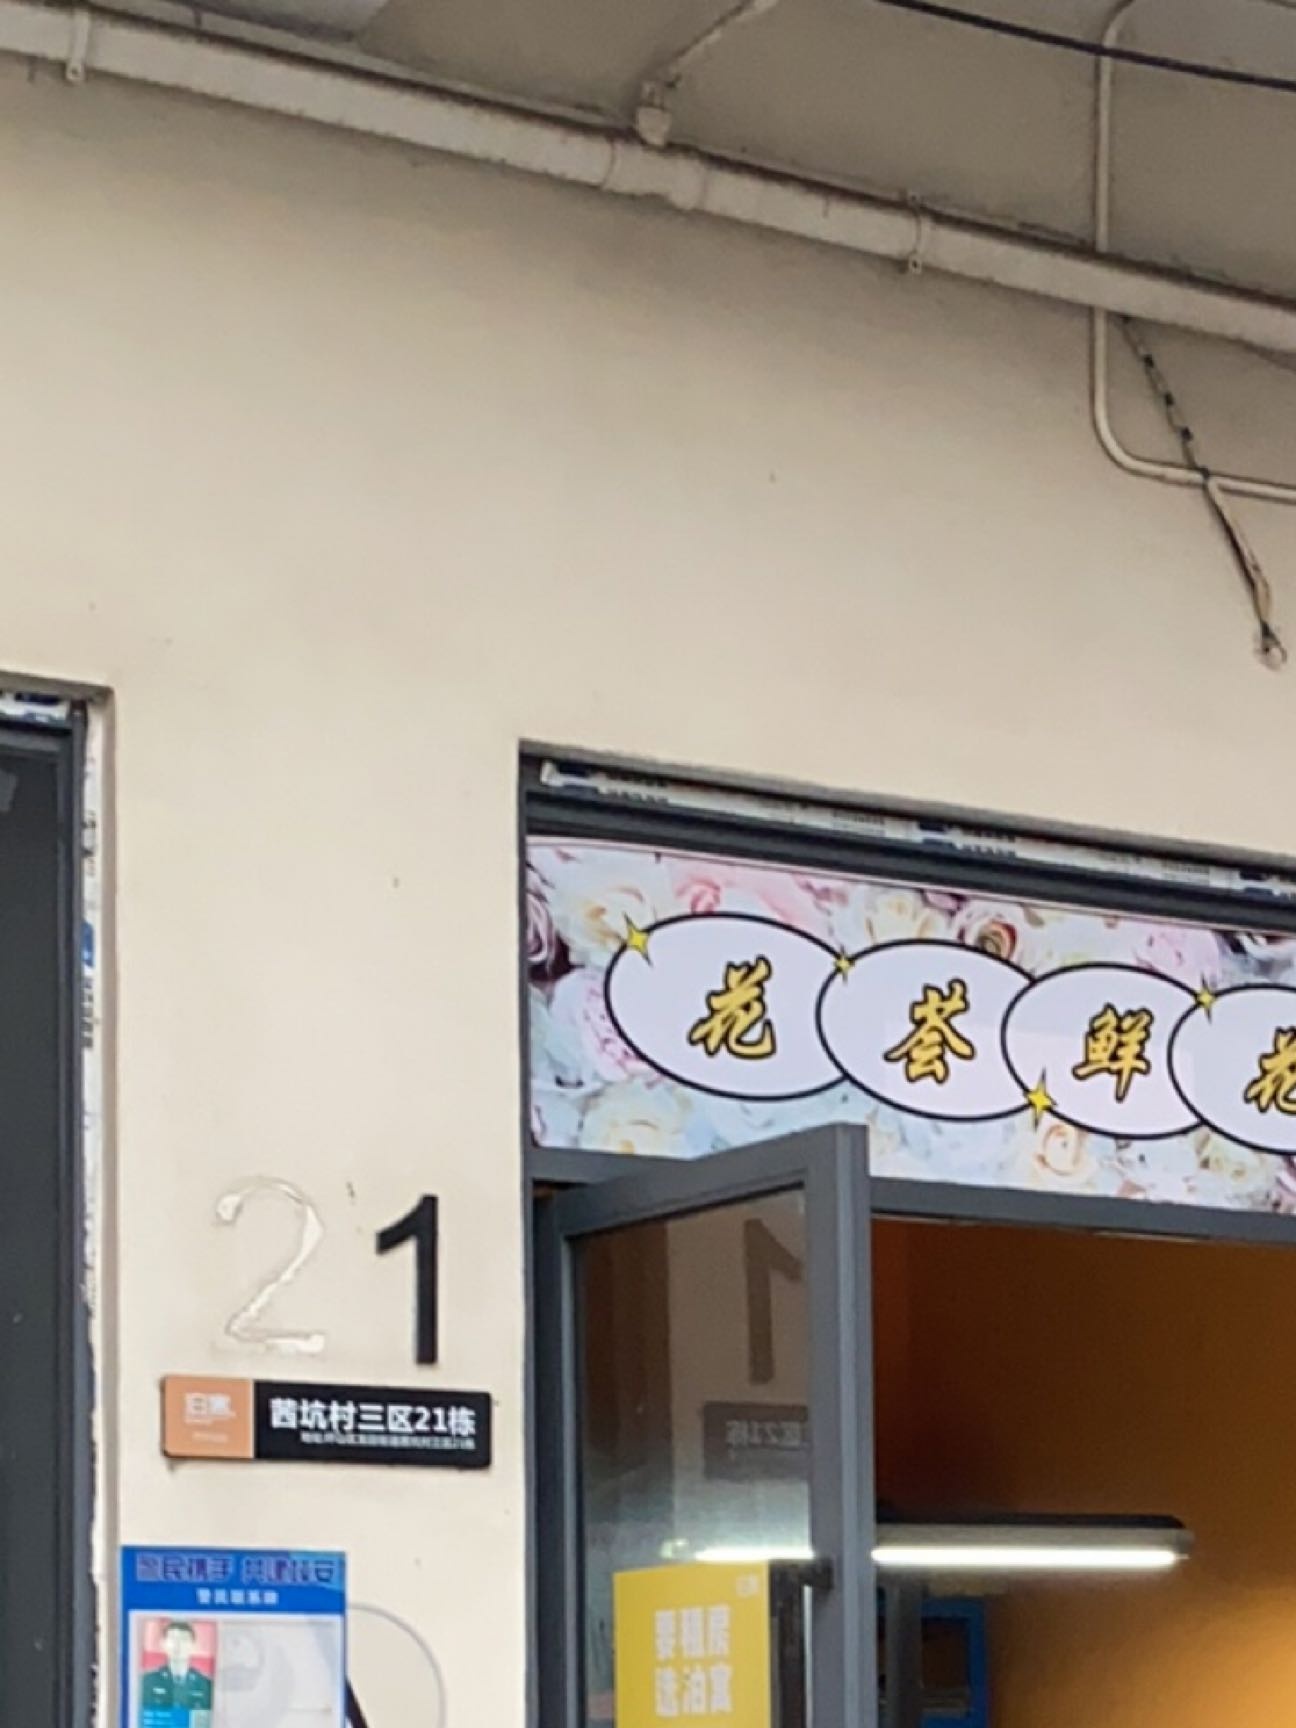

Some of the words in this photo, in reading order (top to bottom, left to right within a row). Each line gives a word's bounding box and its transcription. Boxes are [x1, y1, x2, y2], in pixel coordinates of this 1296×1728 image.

[269, 1396, 477, 1438] 茜坑村三区21栋
